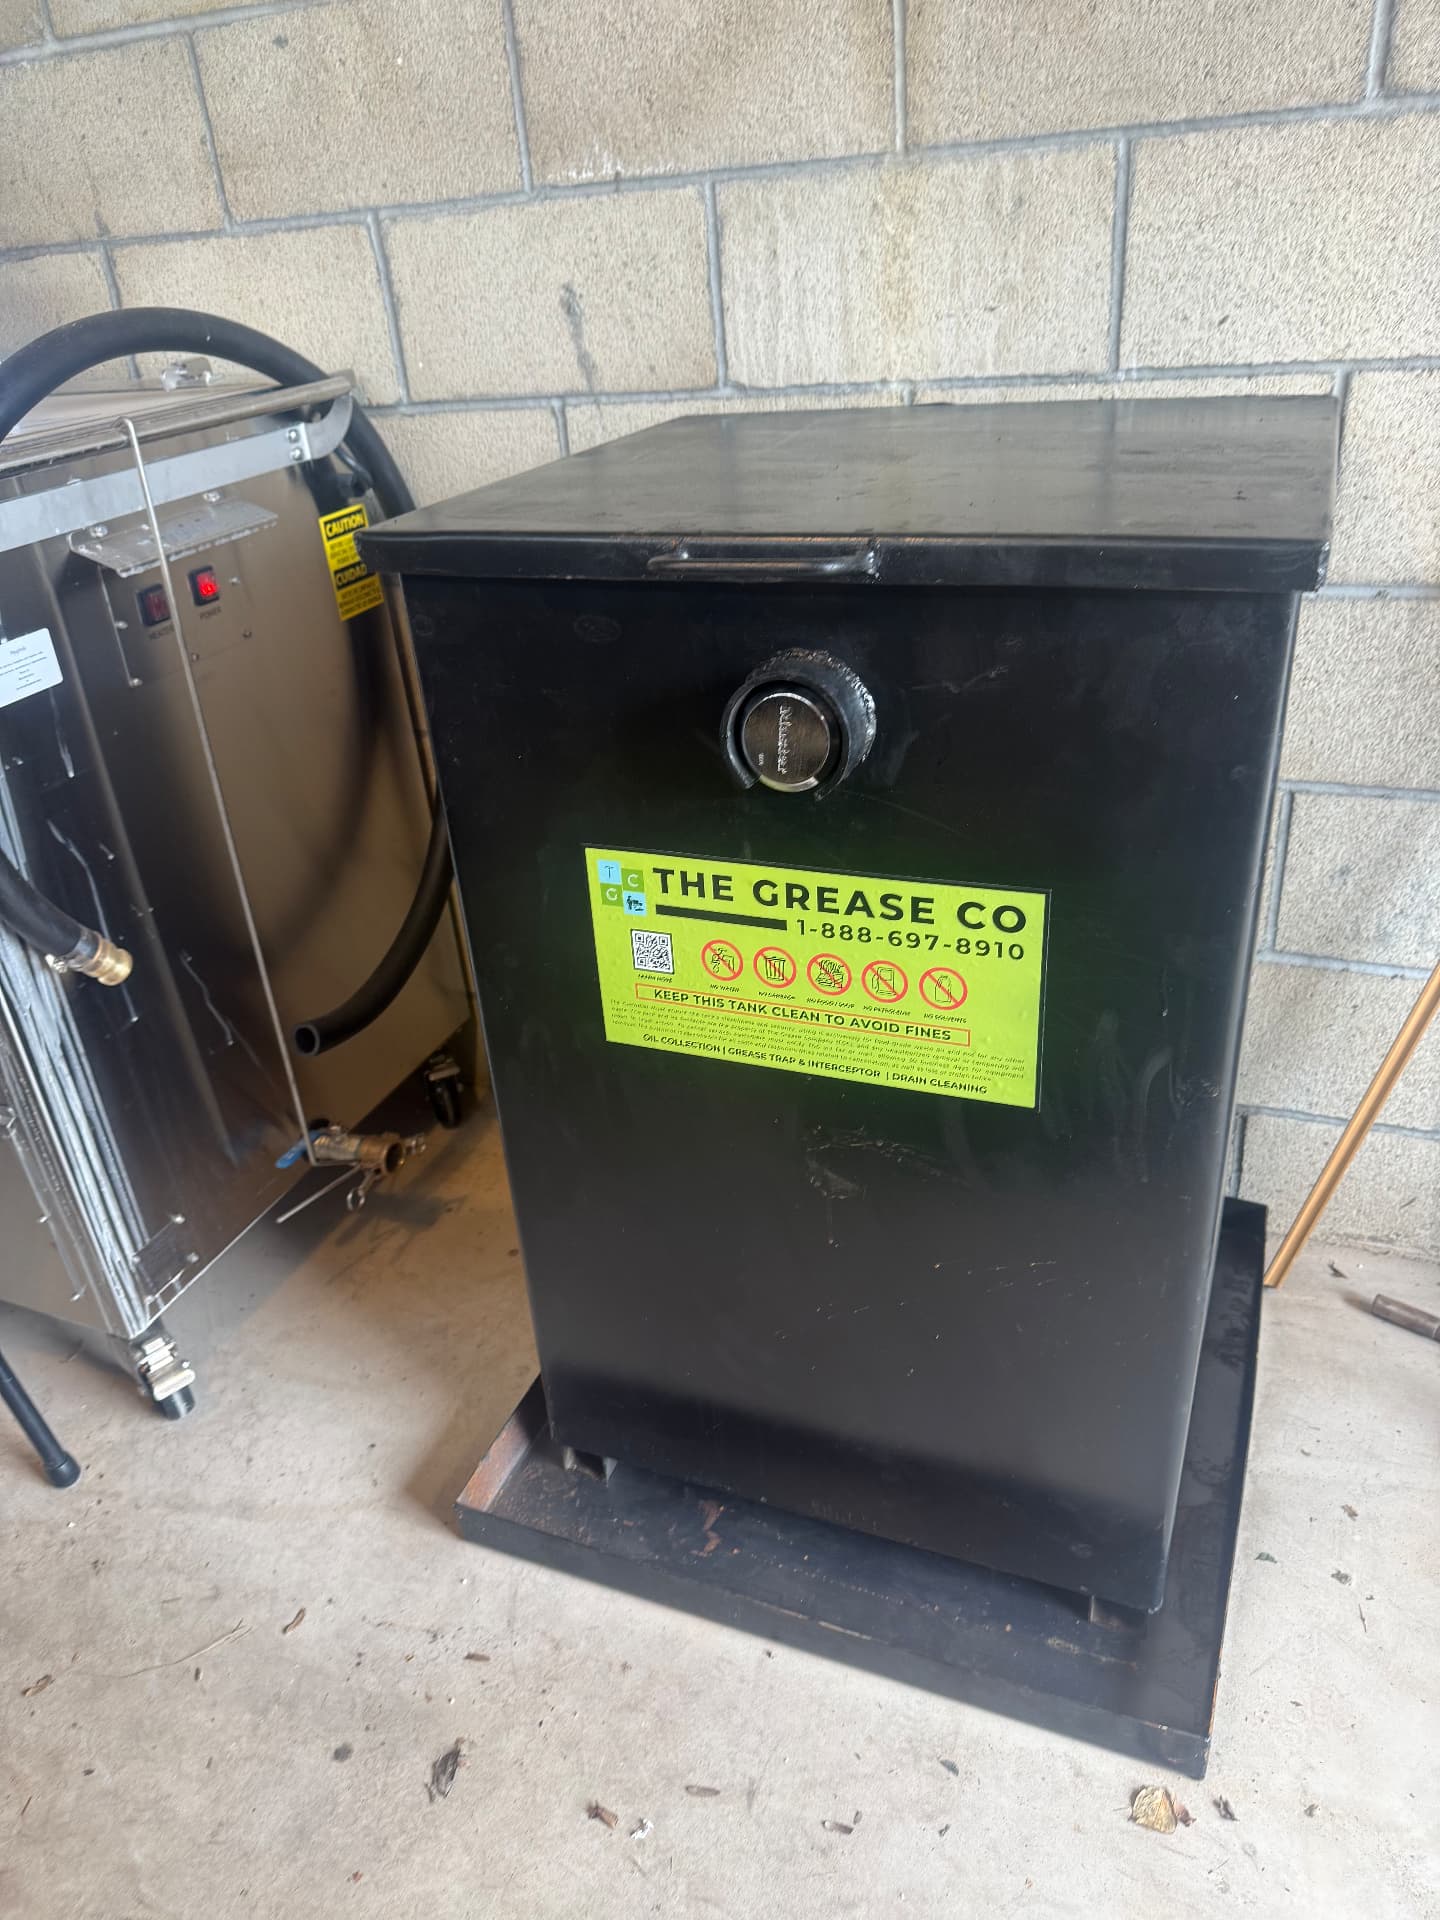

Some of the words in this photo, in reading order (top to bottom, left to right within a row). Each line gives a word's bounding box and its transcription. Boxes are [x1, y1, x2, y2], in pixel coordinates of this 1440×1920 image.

[325, 512, 364, 538] CAUTION
[336, 563, 368, 586] CUIDAD
[604, 865, 614, 879] T
[627, 873, 639, 888] C
[606, 887, 618, 901] G
[652, 867, 734, 902] THE
[752, 879, 936, 926] GREASE
[956, 901, 1028, 934] CO
[796, 919, 1025, 962] 1-888-697-8910
[653, 988, 690, 1003] KEEP
[693, 994, 725, 1009] THIS
[727, 999, 768, 1015] TANK
[771, 1006, 820, 1023] CLEAN
[825, 1013, 845, 1026] TO
[849, 1017, 900, 1034] AVOID
[905, 1025, 952, 1041] FINES
[643, 1033, 659, 1042] OIL
[661, 1036, 721, 1054] COLLECTION
[728, 1047, 767, 1060] GREASE
[769, 1053, 796, 1064] TRAP
[798, 1058, 806, 1066] &
[808, 1060, 881, 1077] INTERCEPTOR
[892, 1072, 927, 1086] DRAIN
[930, 1078, 988, 1095] CLEANING
